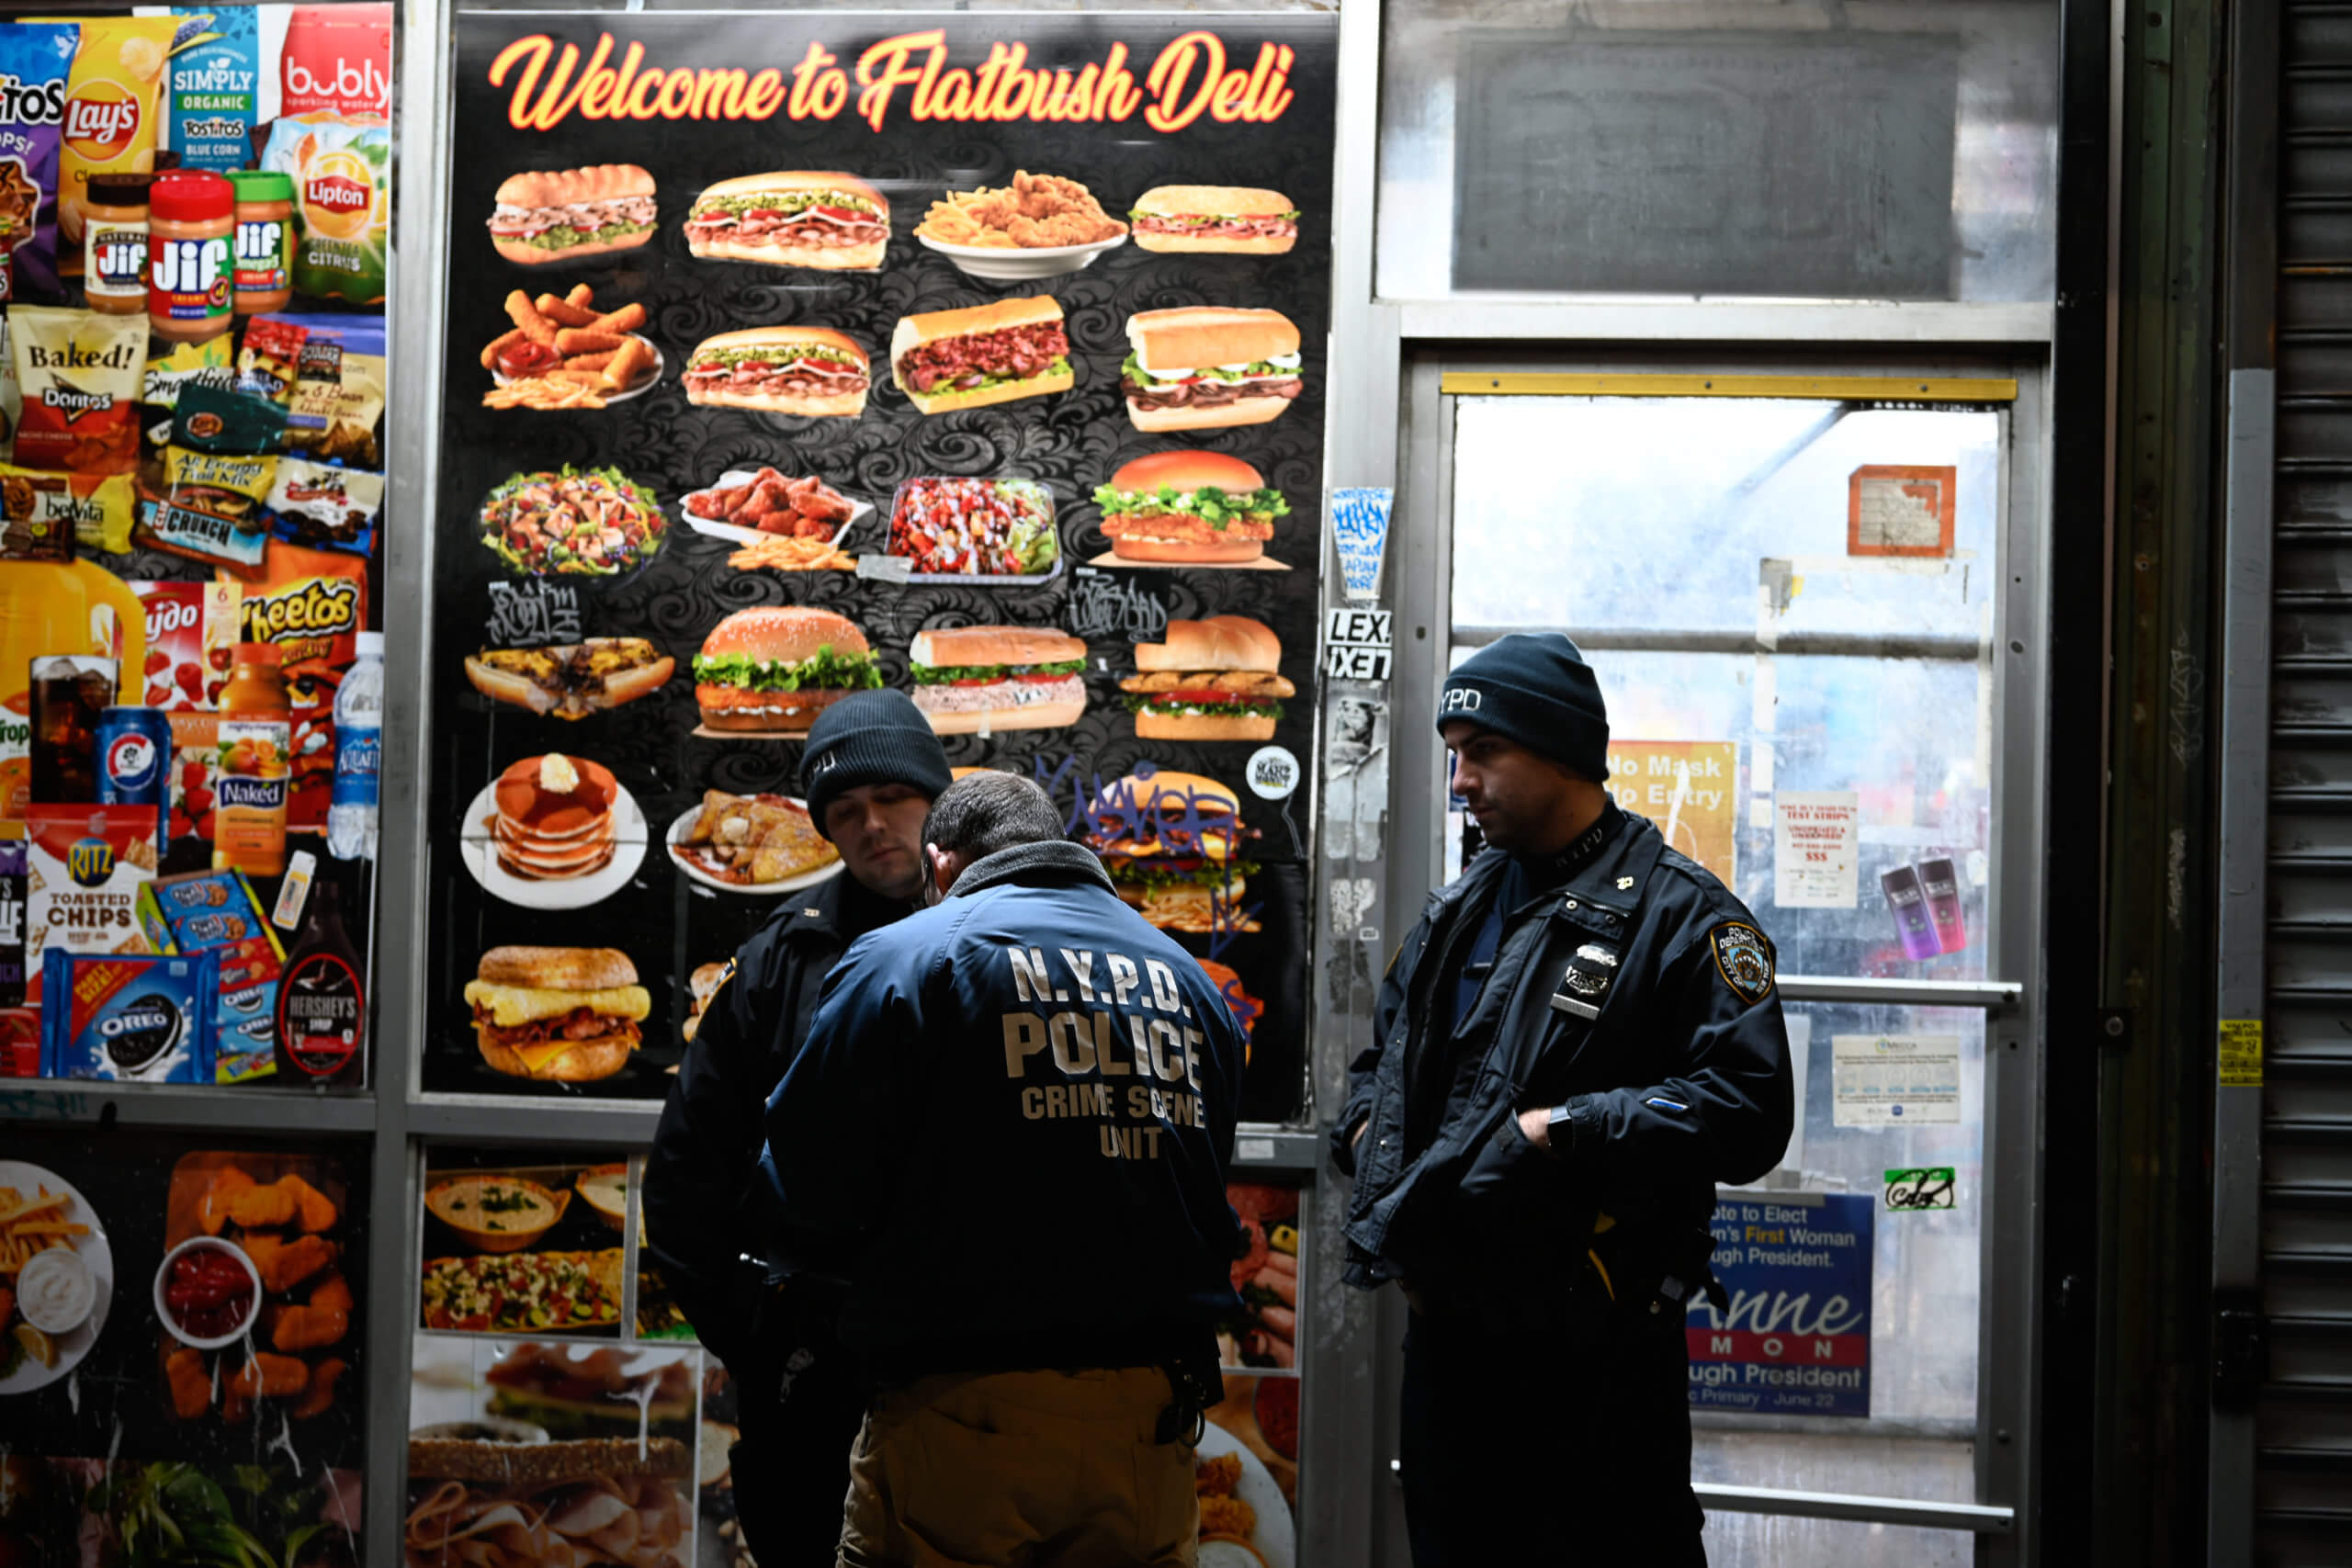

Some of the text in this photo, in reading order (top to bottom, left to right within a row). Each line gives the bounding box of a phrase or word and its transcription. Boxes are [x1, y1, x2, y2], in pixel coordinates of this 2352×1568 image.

[175, 70, 254, 91] SIMPLY
[489, 28, 1295, 133] Welcome to Flatbush Deli
[184, 95, 244, 109] ORGANIC
[66, 99, 136, 143] Lay's
[187, 144, 210, 155] BLUE
[309, 184, 365, 206] Lipton
[233, 222, 281, 258] Jif
[99, 244, 147, 275] Jif
[153, 239, 228, 292] Jif
[28, 344, 135, 369] Baked!
[44, 388, 112, 411] Doritos
[166, 510, 232, 547] CRUNCH
[217, 587, 228, 604] 6
[1330, 613, 1392, 643] LEX!
[1648, 755, 1722, 778] Mask
[224, 782, 279, 803] Naked
[1648, 784, 1723, 812] Entry
[68, 843, 114, 882] RITZ
[51, 892, 131, 906] TOASTED
[47, 907, 131, 929] CHIPS
[1008, 947, 1192, 1019] N.Y.P.D.
[289, 996, 356, 1019] HERSHEY'S
[101, 1013, 168, 1036] OREO
[1002, 1011, 1204, 1093] POLICE
[1022, 1082, 1205, 1129] CRIME SCENE
[1100, 1124, 1163, 1160] UNIT
[1742, 1206, 1760, 1222] to
[1764, 1205, 1808, 1224] Elect
[1746, 1225, 1785, 1245] First
[1790, 1228, 1855, 1247] Woman
[1748, 1247, 1835, 1268] President.
[1687, 1286, 1863, 1337] Anne
[1745, 1363, 1861, 1388] President
[1702, 1388, 1760, 1406] Primary
[1773, 1392, 1812, 1407] June
[1815, 1393, 1836, 1408] 22
